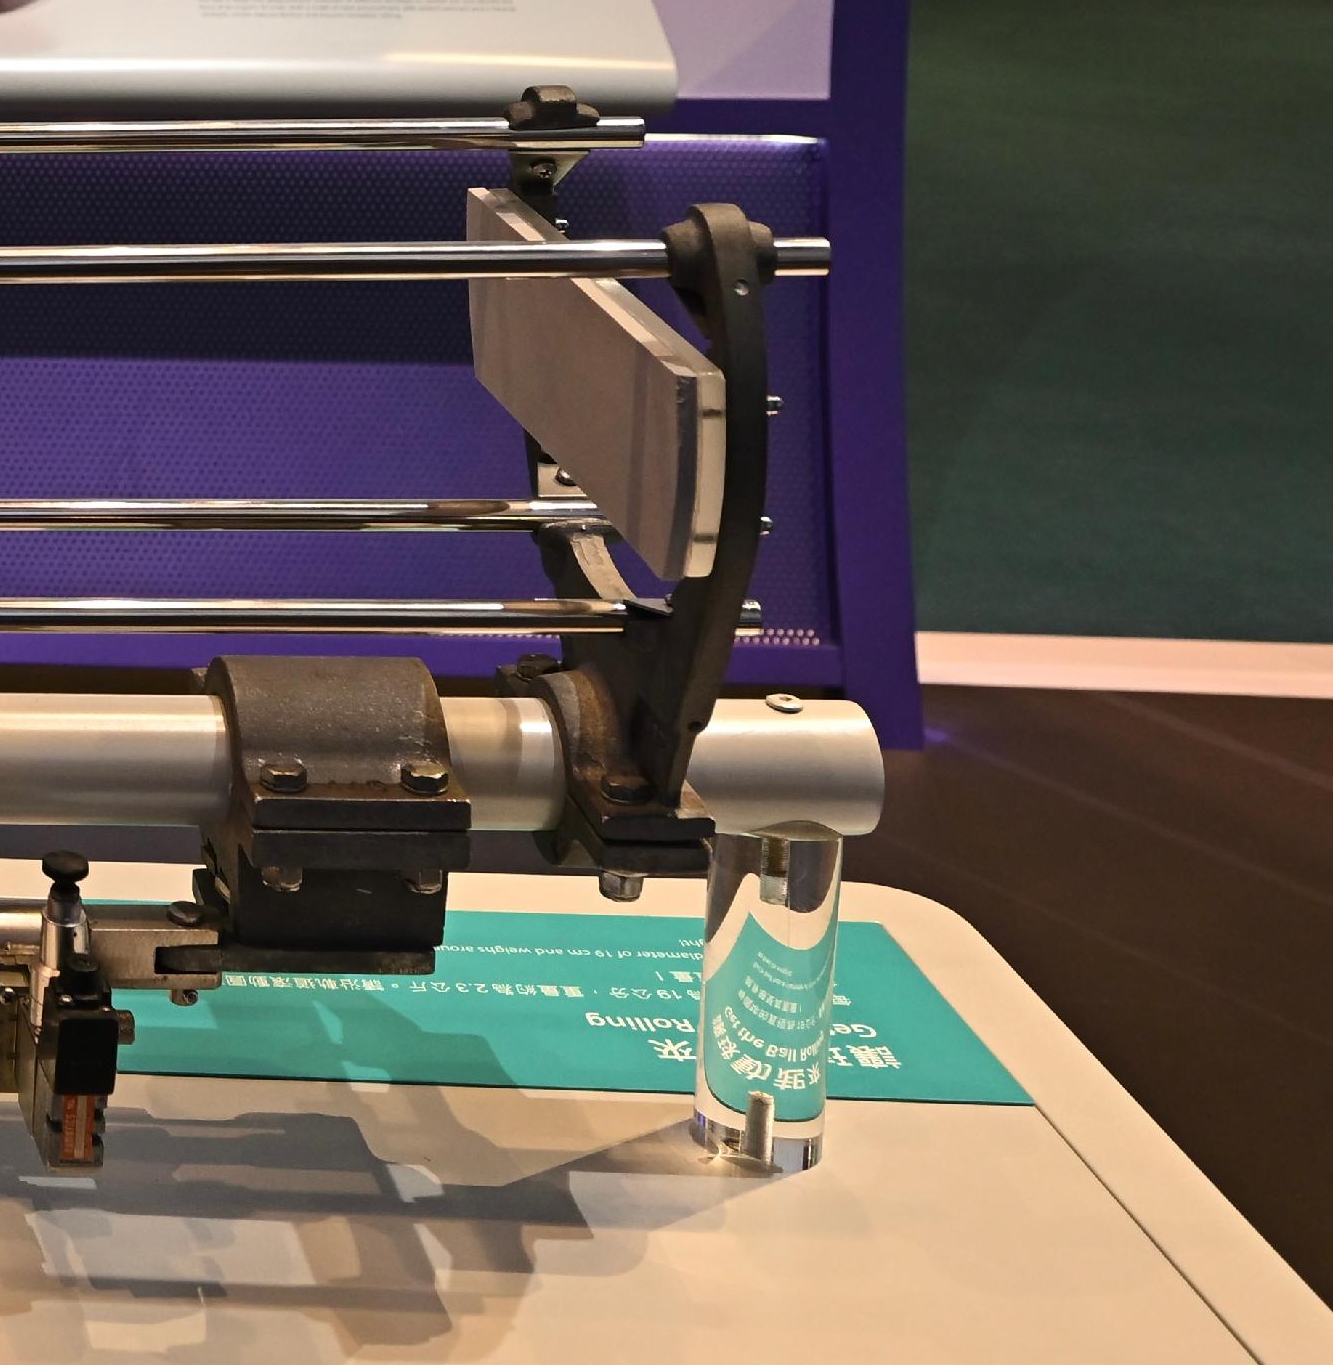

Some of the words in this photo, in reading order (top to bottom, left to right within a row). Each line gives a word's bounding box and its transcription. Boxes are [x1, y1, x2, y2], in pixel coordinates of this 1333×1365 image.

[477, 944, 532, 955] weighs
[535, 947, 563, 957] and
[569, 948, 590, 956] cm
[595, 948, 614, 959] 19
[616, 949, 632, 960] of
[585, 1012, 695, 1033] Rolling
